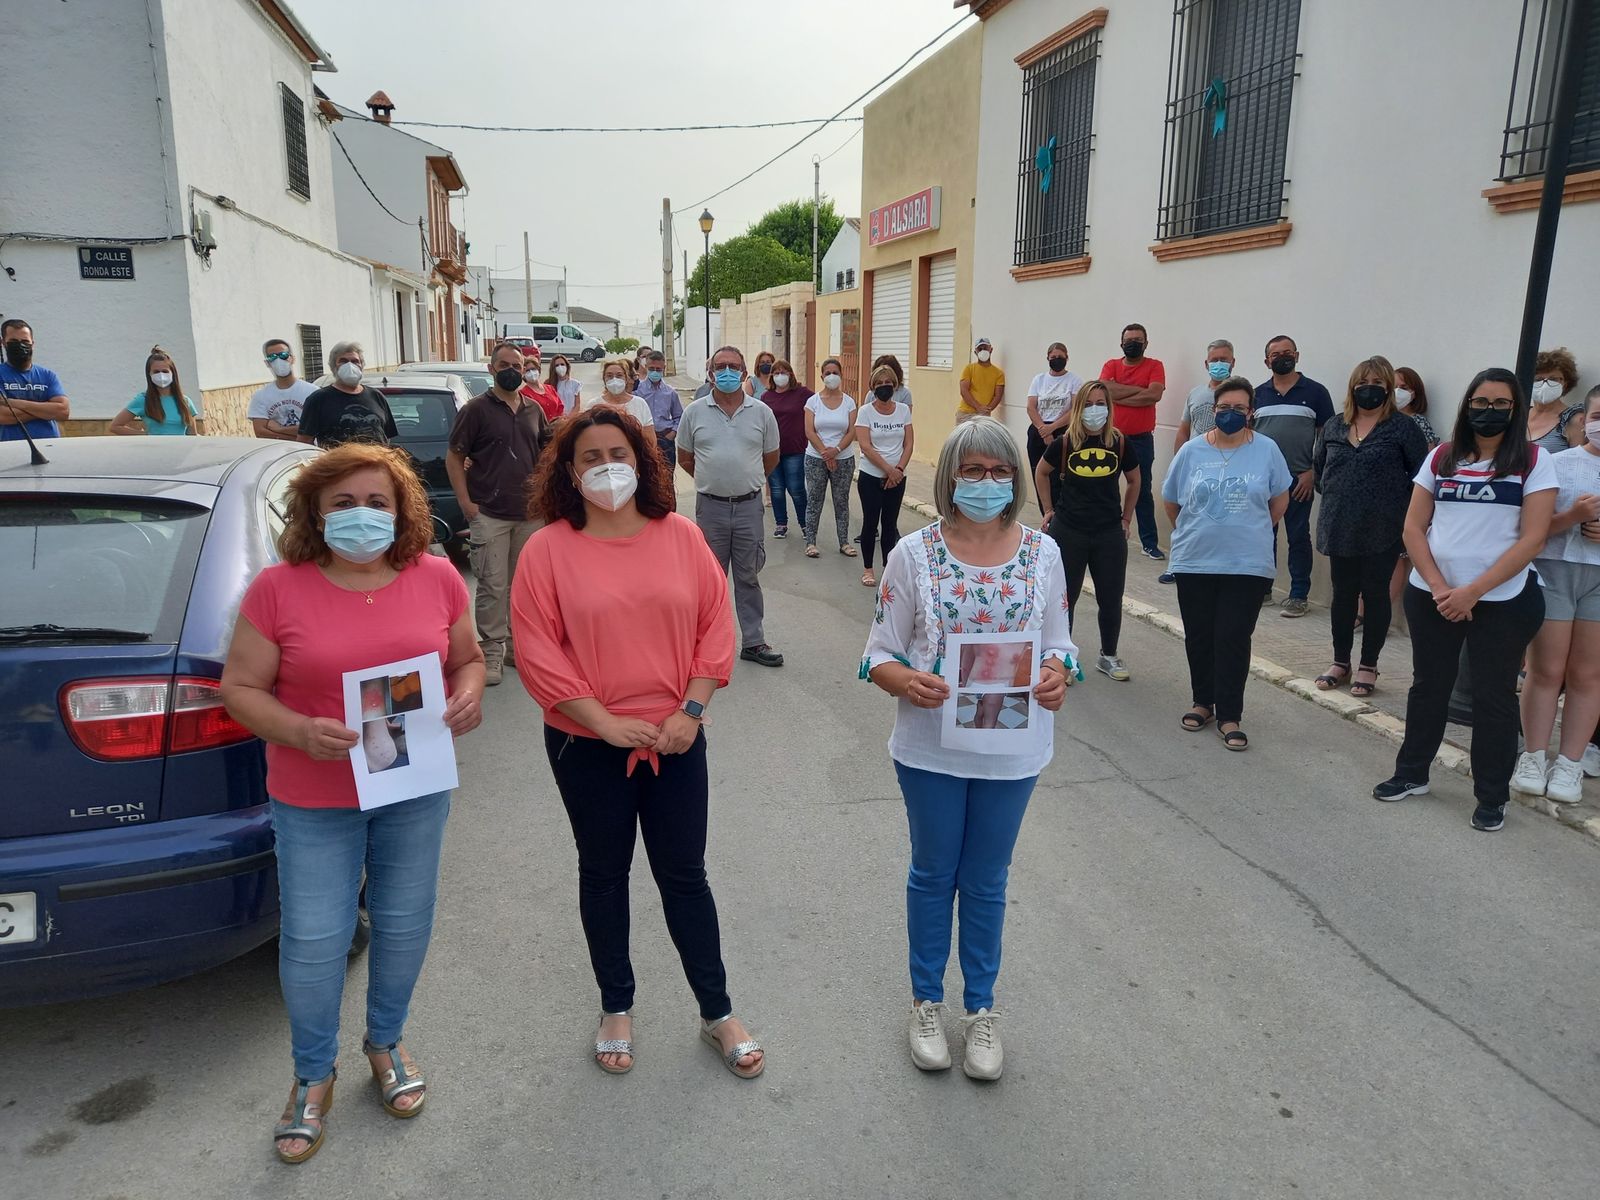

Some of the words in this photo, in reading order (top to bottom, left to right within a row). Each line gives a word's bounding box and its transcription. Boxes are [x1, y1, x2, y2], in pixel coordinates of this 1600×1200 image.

[883, 195, 927, 237] D'ALSARA
[95, 252, 127, 261] CALLE
[83, 266, 109, 276] RONDA
[111, 267, 131, 276] ESTE
[873, 422, 904, 430] Bonjour
[1438, 482, 1496, 501] FILA
[70, 802, 144, 818] LEON
[115, 813, 145, 822] TDI
